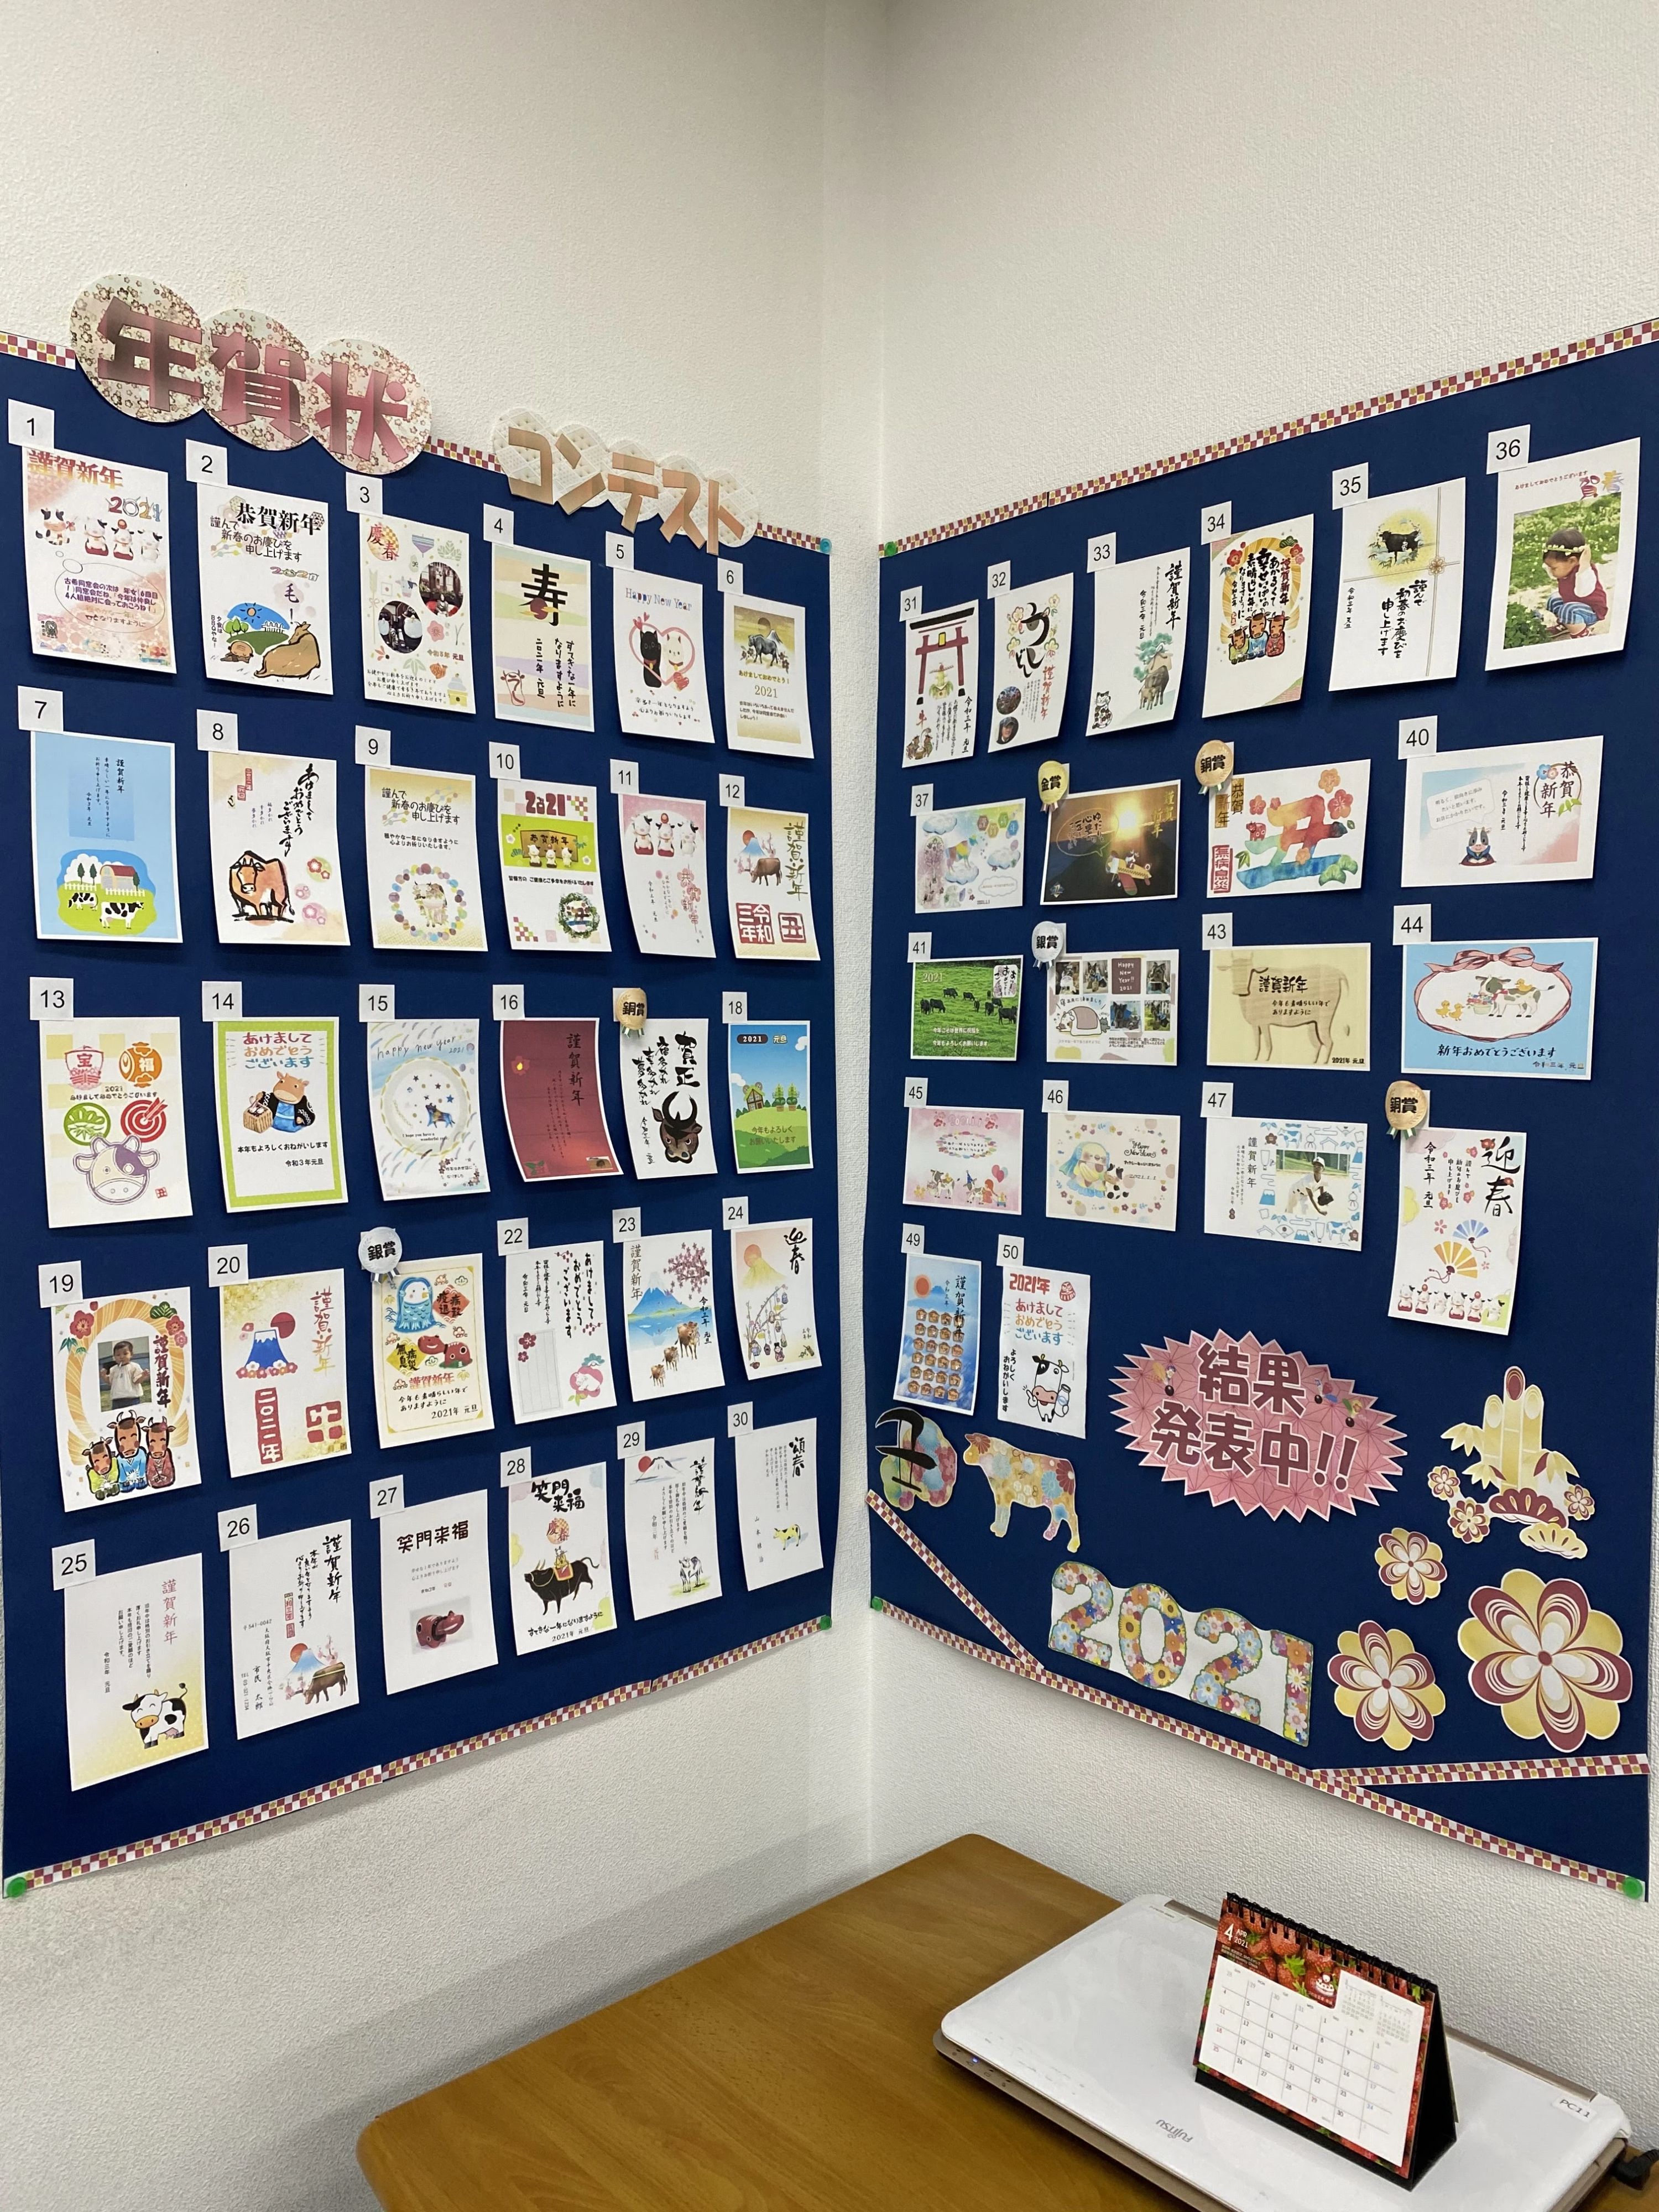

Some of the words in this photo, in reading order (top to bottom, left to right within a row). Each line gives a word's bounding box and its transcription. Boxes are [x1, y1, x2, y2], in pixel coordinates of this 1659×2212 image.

[97, 296, 410, 464] 年賀状
[27, 418, 35, 436] 1
[1495, 439, 1520, 460] 36
[28, 448, 123, 488] 謹賀新年
[201, 455, 213, 473] 2
[1340, 476, 1361, 496] 35
[1515, 469, 1588, 490] あけましておめでとうございます
[1580, 469, 1624, 500] 賀春
[359, 487, 370, 503] 3
[508, 426, 745, 555] コンテスト
[107, 497, 161, 521] 2021
[210, 516, 239, 530] 謹んで
[236, 503, 321, 536] 恭賀新年
[494, 518, 503, 534] 4
[1208, 514, 1224, 532] 34
[221, 529, 292, 550] 新春のお慶びを
[367, 524, 399, 560] 慶春
[246, 546, 302, 562] 申し上げます
[615, 545, 624, 559] 5
[1094, 544, 1110, 561] 33
[726, 570, 734, 584] 6
[992, 572, 1006, 588] 32
[1256, 548, 1271, 607] 幸せいっぱいの
[1269, 556, 1280, 607] あかるくて
[1280, 558, 1290, 605] 謹賀新年
[518, 563, 568, 627] 寿
[625, 587, 651, 605] Happy
[654, 594, 671, 607] New
[674, 598, 692, 611] Year
[1165, 560, 1182, 630] 謹賀新年
[1409, 580, 1427, 606] 謹んで
[904, 597, 916, 611] 31
[1378, 597, 1394, 655] 申し上げます
[1391, 587, 1411, 658] 初春のお慶びを
[555, 638, 564, 708] なりますように
[754, 685, 778, 698] 2021
[1041, 666, 1056, 720] 謹賀新年
[34, 701, 47, 719] 7
[212, 723, 223, 740] 8
[1406, 728, 1429, 747] 40
[368, 738, 378, 754] 9
[497, 753, 514, 769] 10
[1201, 755, 1225, 773] 銅賞
[116, 758, 125, 794] 謹賀新年
[618, 770, 631, 785] 11
[1041, 775, 1062, 791] 金賞
[382, 787, 406, 799] 謹んで
[726, 784, 739, 799] 12
[915, 793, 929, 807] 37
[1232, 783, 1244, 815] 恭賀
[391, 800, 451, 814] 新春のお慶びを
[525, 791, 566, 817] 2021
[412, 812, 460, 825] 申し上げます
[784, 821, 808, 901] 謹賀新年
[736, 902, 775, 945] 令和三年
[1207, 924, 1226, 940] 43
[1401, 916, 1423, 933] 44
[912, 941, 926, 954] 41
[1036, 935, 1058, 950] 銀賞
[1259, 975, 1308, 993] 謹賀新年
[40, 990, 65, 1008] 13
[212, 993, 234, 1010] 14
[368, 995, 388, 1011] 15
[500, 994, 518, 1010] 16
[729, 1001, 742, 1014] 18
[622, 1002, 645, 1016] 銅賞
[243, 1032, 312, 1045] あけまして
[773, 1035, 787, 1044] 元旦
[244, 1046, 312, 1057] おめでとう
[675, 1031, 700, 1087] 賀正
[1437, 1044, 1556, 1058] 新年おめでとうございます
[139, 1057, 154, 1072] 福
[245, 1056, 314, 1069] ございます
[566, 1033, 584, 1107] 謹賀新年
[909, 1086, 923, 1099] 45
[1047, 1090, 1063, 1104] 46
[1208, 1093, 1227, 1108] 47
[1390, 1097, 1418, 1113] 銅賞
[237, 1141, 328, 1153] 本年もよろしくおねがいします
[749, 1136, 796, 1145] お願いいたします
[1246, 1137, 1258, 1188] 謹賀新年
[1423, 1142, 1436, 1187] 令和三年
[1481, 1136, 1521, 1217] 迎春
[1423, 1191, 1433, 1209] 元旦
[728, 1206, 743, 1220] 24
[619, 1217, 635, 1233] 23
[504, 1229, 523, 1244] 22
[906, 1233, 920, 1246] 49
[368, 1241, 396, 1261] 銀賞
[784, 1227, 807, 1275] 迎春
[1003, 1245, 1018, 1259] 50
[217, 1256, 240, 1274] 20
[631, 1244, 643, 1301] 謹賀新年
[49, 1274, 74, 1293] 19
[573, 1259, 582, 1326] おめでとう
[585, 1253, 594, 1319] あけまして
[1009, 1273, 1050, 1295] 2021年
[564, 1267, 572, 1338] ございます
[700, 1296, 710, 1327] 令和三年
[1015, 1298, 1063, 1317] あけまして
[1015, 1314, 1063, 1330] おめでとう
[310, 1286, 335, 1377] 謹賀新年
[1015, 1329, 1063, 1346] ございます
[153, 1335, 171, 1408] 謹賀新年
[409, 1373, 455, 1390] 謹賀新年
[1197, 1344, 1306, 1418] 結果
[400, 1399, 447, 1412] ありますように
[431, 1407, 459, 1420] 2021年
[464, 1404, 478, 1413] 元旦
[733, 1412, 748, 1427] 30
[623, 1432, 640, 1448] 29
[1151, 1400, 1359, 1492] 発表中!!
[507, 1458, 525, 1476] 28
[377, 1487, 397, 1506] 27
[227, 1517, 250, 1538] 26
[397, 1520, 469, 1553] 笑門来福
[61, 1553, 87, 1576] 25
[322, 1534, 342, 1603] 謹賀新年
[161, 1579, 178, 1645] 謹賀新年
[528, 1611, 603, 1637] すてきな一年になりますように
[1050, 1562, 1313, 1746] 2021
[1224, 1923, 1234, 1940] 4
[1236, 1928, 1248, 1939] APR
[1234, 1937, 1248, 1949] 2021
[1559, 2099, 1590, 2118] PC11
[1155, 2119, 1194, 2143] FUJITSU
